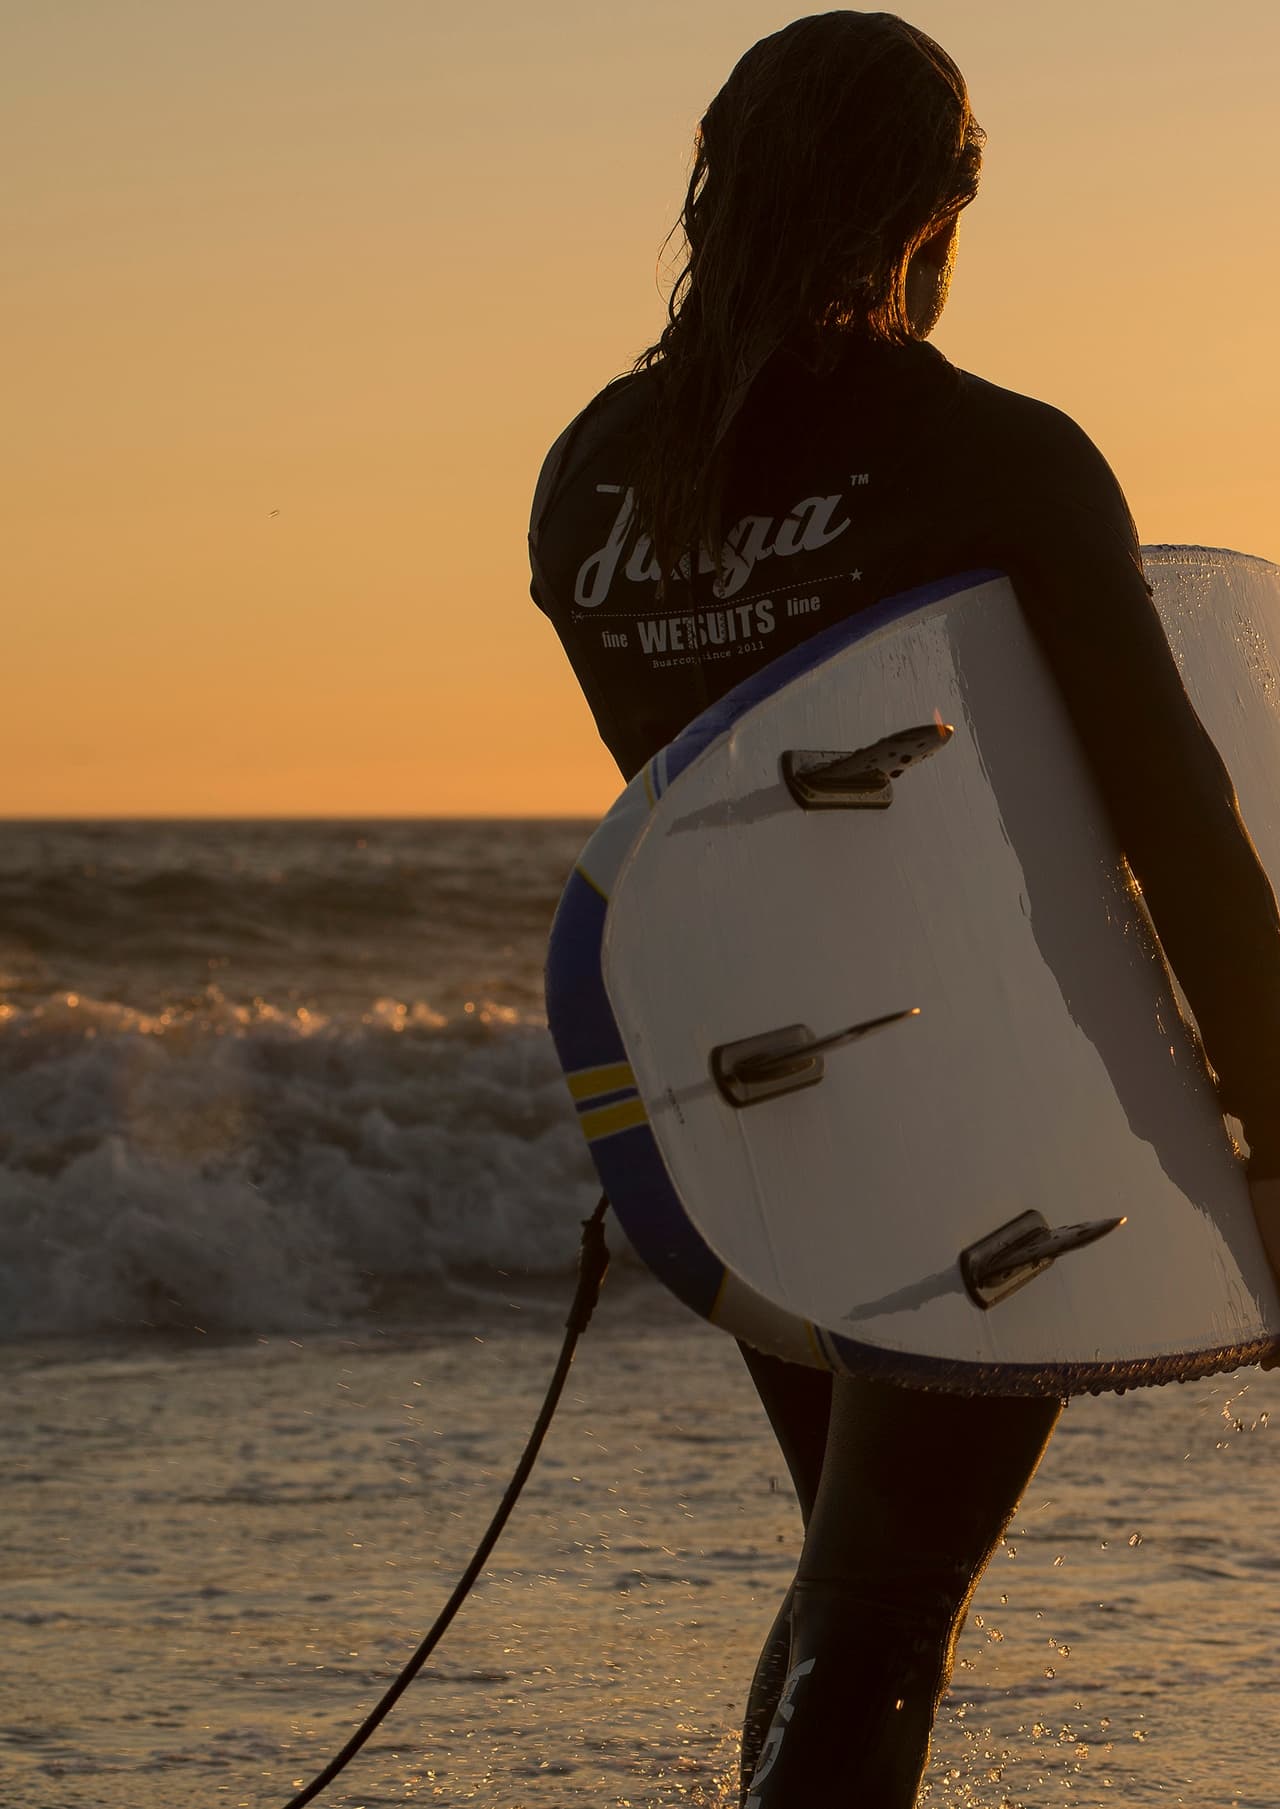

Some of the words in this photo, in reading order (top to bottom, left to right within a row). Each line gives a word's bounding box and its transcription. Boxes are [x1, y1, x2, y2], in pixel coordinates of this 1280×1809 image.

[602, 631, 628, 649] fine
[787, 595, 821, 617] line
[702, 650, 732, 661] ince
[737, 640, 766, 655] 2011
